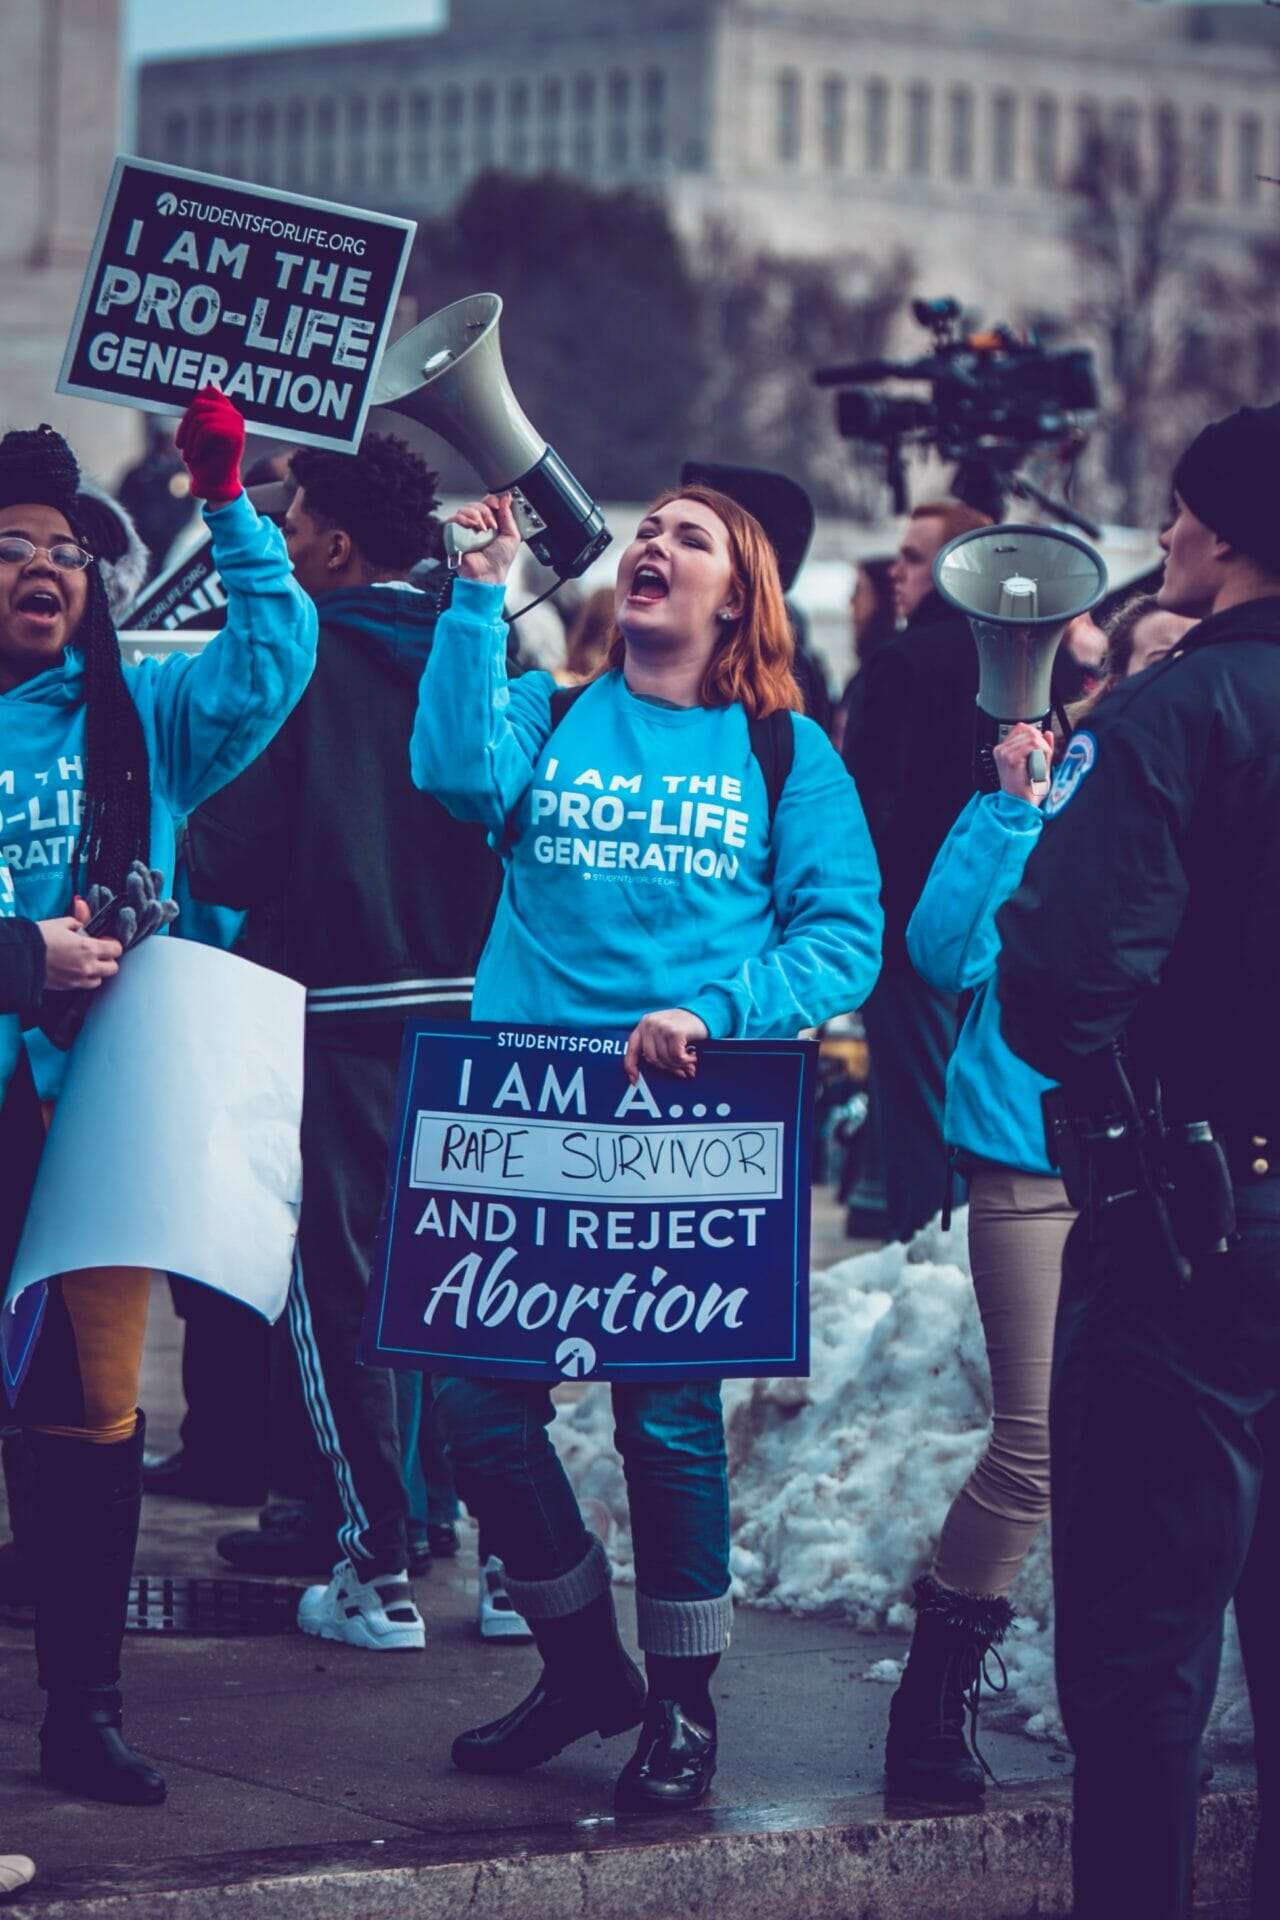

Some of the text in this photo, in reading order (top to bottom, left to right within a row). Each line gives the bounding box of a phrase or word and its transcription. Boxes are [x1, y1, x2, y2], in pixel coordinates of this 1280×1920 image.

[178, 199, 366, 256] STUDENTSFORLIFE.ORG
[125, 218, 373, 306] I AM THE
[94, 264, 375, 371] PRO-LIFE
[88, 331, 353, 421] GENERATION
[544, 758, 742, 802] I AM THE
[531, 789, 749, 848] PRO-LIFE
[534, 835, 740, 881] GENERATION
[497, 1031, 629, 1056] STUDENTSFORLI
[458, 1058, 731, 1118] I AM A...
[440, 1123, 766, 1183] RAPE SURVIVOR
[414, 1197, 766, 1250] AND I REJECT
[423, 1246, 749, 1334] Abortion
